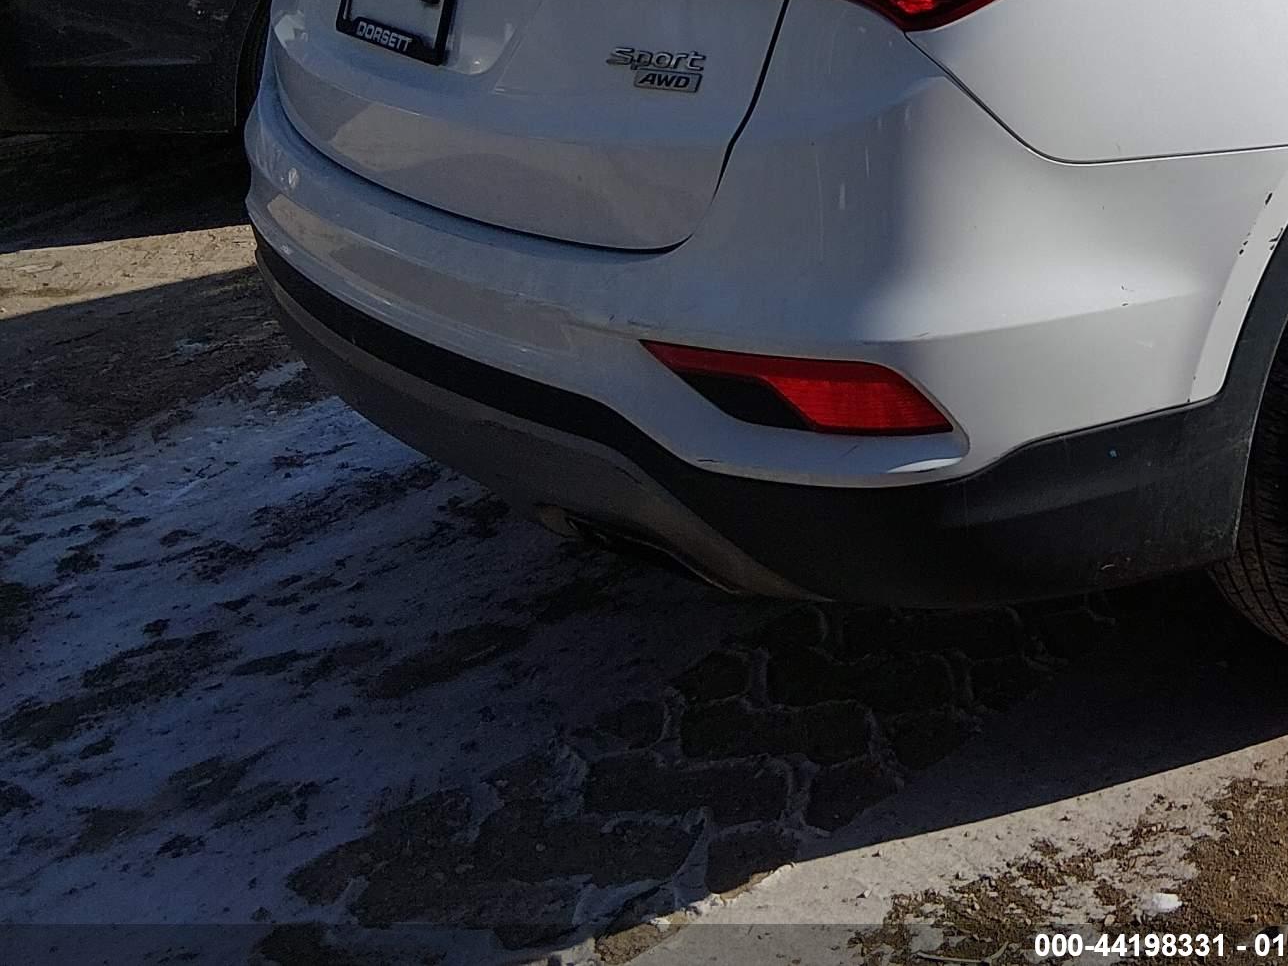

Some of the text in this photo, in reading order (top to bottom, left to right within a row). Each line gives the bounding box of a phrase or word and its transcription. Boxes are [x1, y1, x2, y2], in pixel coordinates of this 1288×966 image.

[356, 20, 413, 52] DORSETT
[607, 47, 706, 71] Sport
[638, 73, 691, 89] AWD
